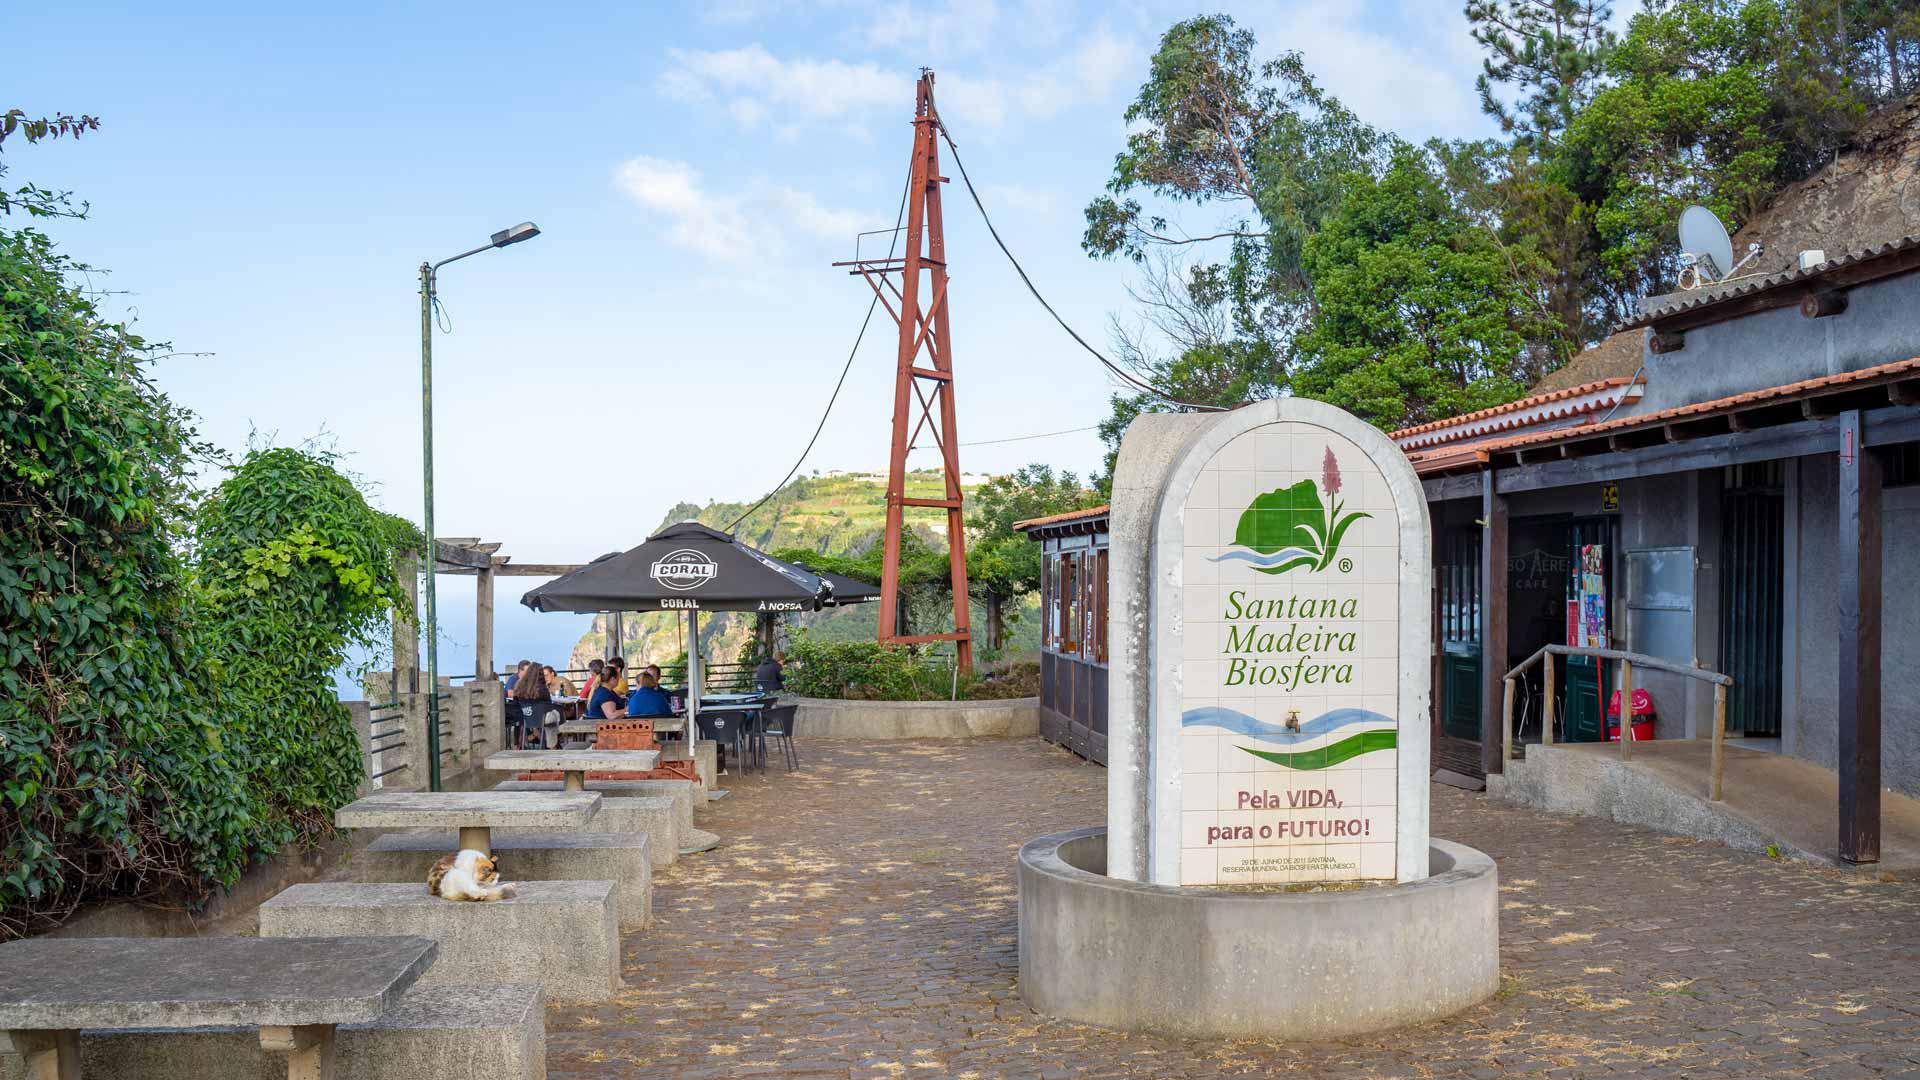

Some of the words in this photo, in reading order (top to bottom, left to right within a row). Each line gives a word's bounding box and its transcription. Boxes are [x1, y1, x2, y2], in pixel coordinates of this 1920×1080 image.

[660, 564, 709, 575] CORAL
[1530, 557, 1566, 576] AERE
[660, 598, 700, 609] CORAL
[768, 602, 803, 611] NOSSA
[1224, 590, 1358, 620] Santana
[1221, 623, 1357, 654] Madeira
[1223, 654, 1353, 692] Biosfera
[1237, 789, 1281, 809] Pela
[1286, 789, 1344, 809] VIDA,
[1207, 824, 1254, 845] para
[1258, 825, 1273, 839] o
[1277, 818, 1370, 839] FUTURO!
[1222, 865, 1251, 873] RESERVA
